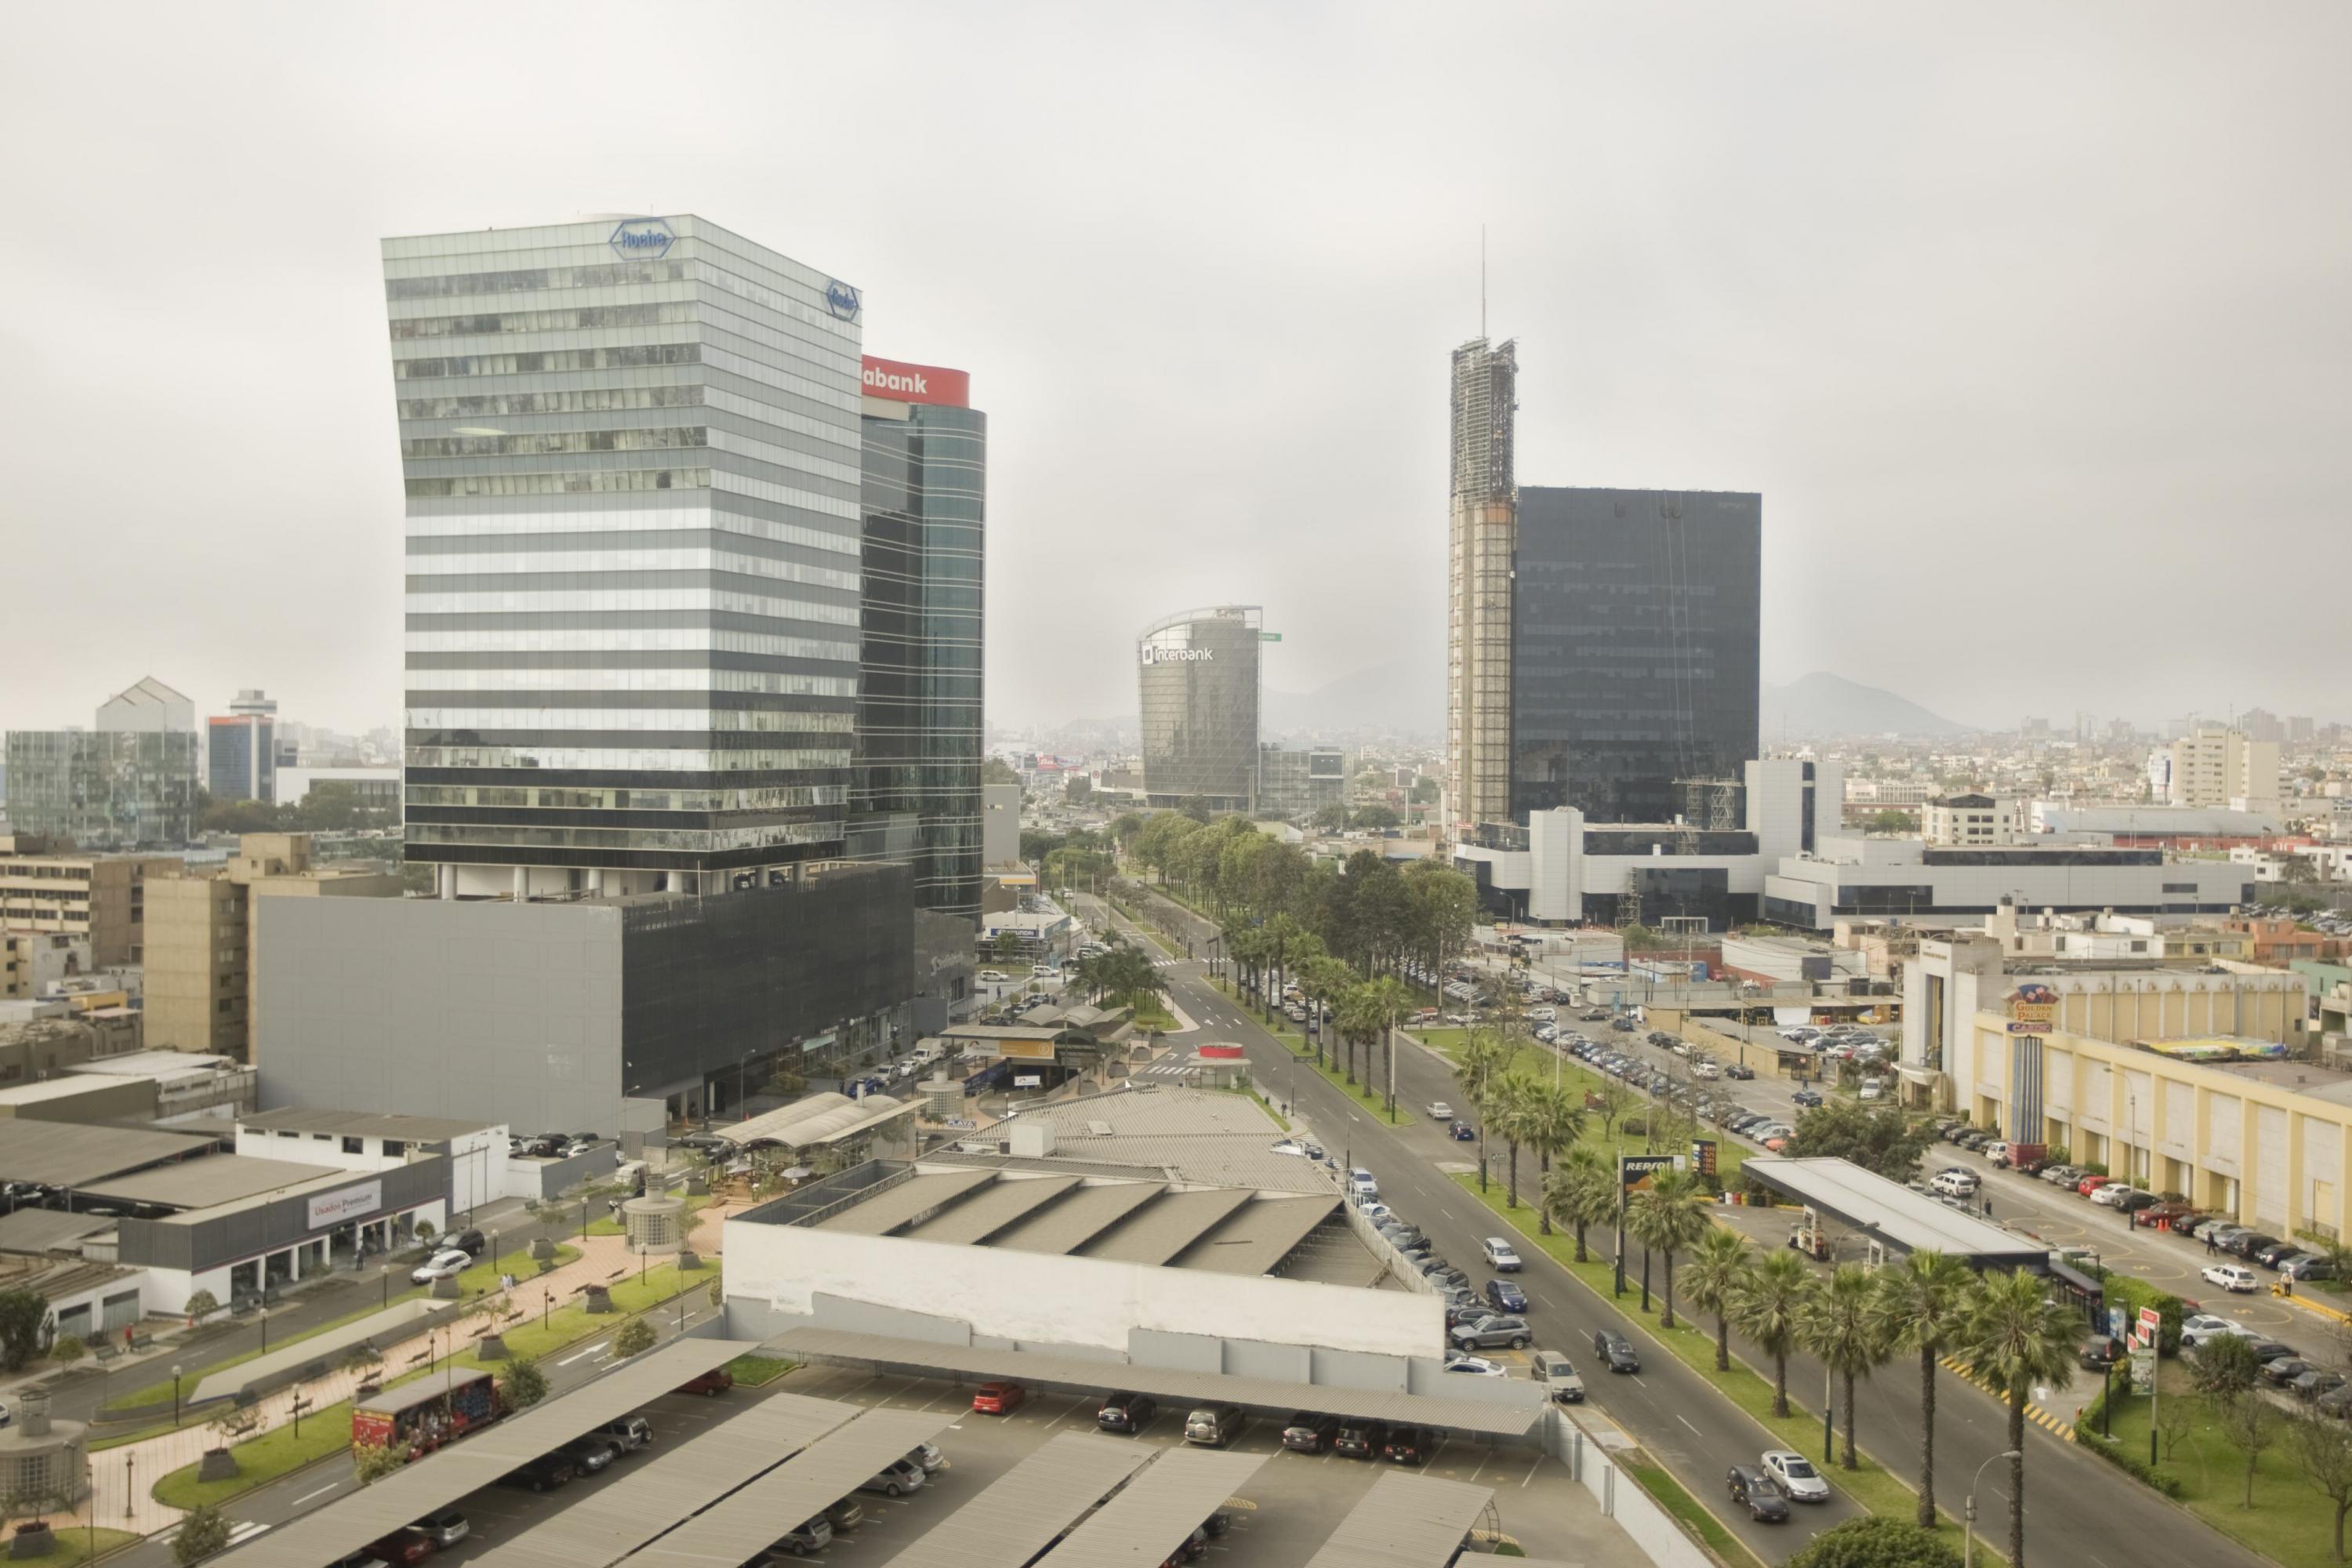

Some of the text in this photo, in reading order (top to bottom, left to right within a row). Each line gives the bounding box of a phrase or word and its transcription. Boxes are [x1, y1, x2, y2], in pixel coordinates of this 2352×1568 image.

[863, 367, 927, 394] abank
[1155, 647, 1214, 661] Interbank
[314, 1193, 372, 1216] Usados Premium
